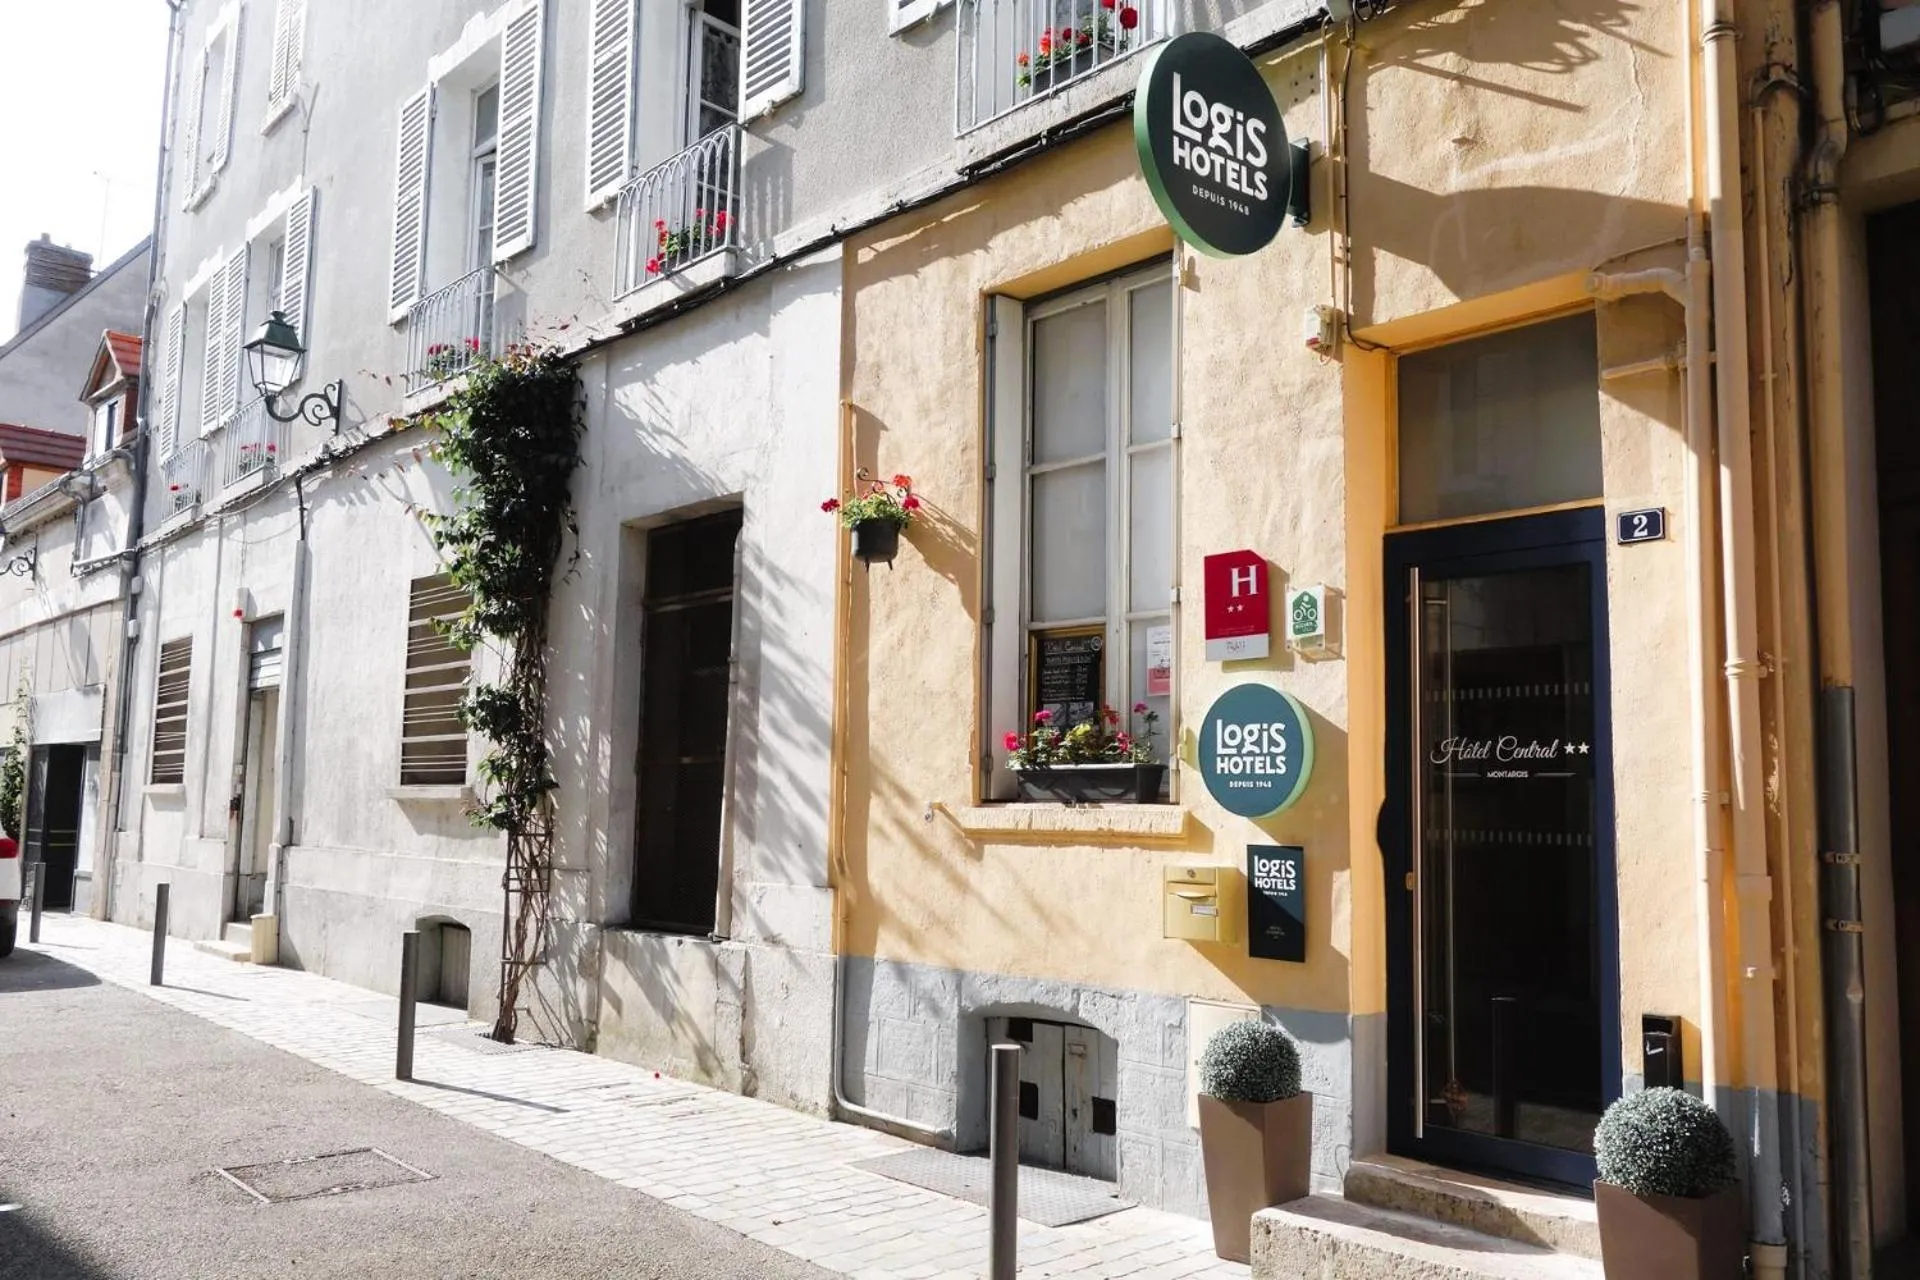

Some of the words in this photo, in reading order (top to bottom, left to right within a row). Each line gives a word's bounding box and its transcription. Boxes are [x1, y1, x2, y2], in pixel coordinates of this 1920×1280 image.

[1173, 135, 1268, 201] HOTELS
[1192, 184, 1225, 206] DEPUIS
[1228, 199, 1250, 216] 1948
[1632, 514, 1649, 537] 2
[1230, 564, 1260, 598] H
[1430, 736, 1492, 764] Hôtel
[1496, 735, 1559, 762] Central
[1216, 755, 1287, 775] HOTELS
[1486, 770, 1529, 778] MONTARGIS
[1229, 780, 1254, 788] DEPUIS
[1254, 877, 1296, 891] HOTELS
